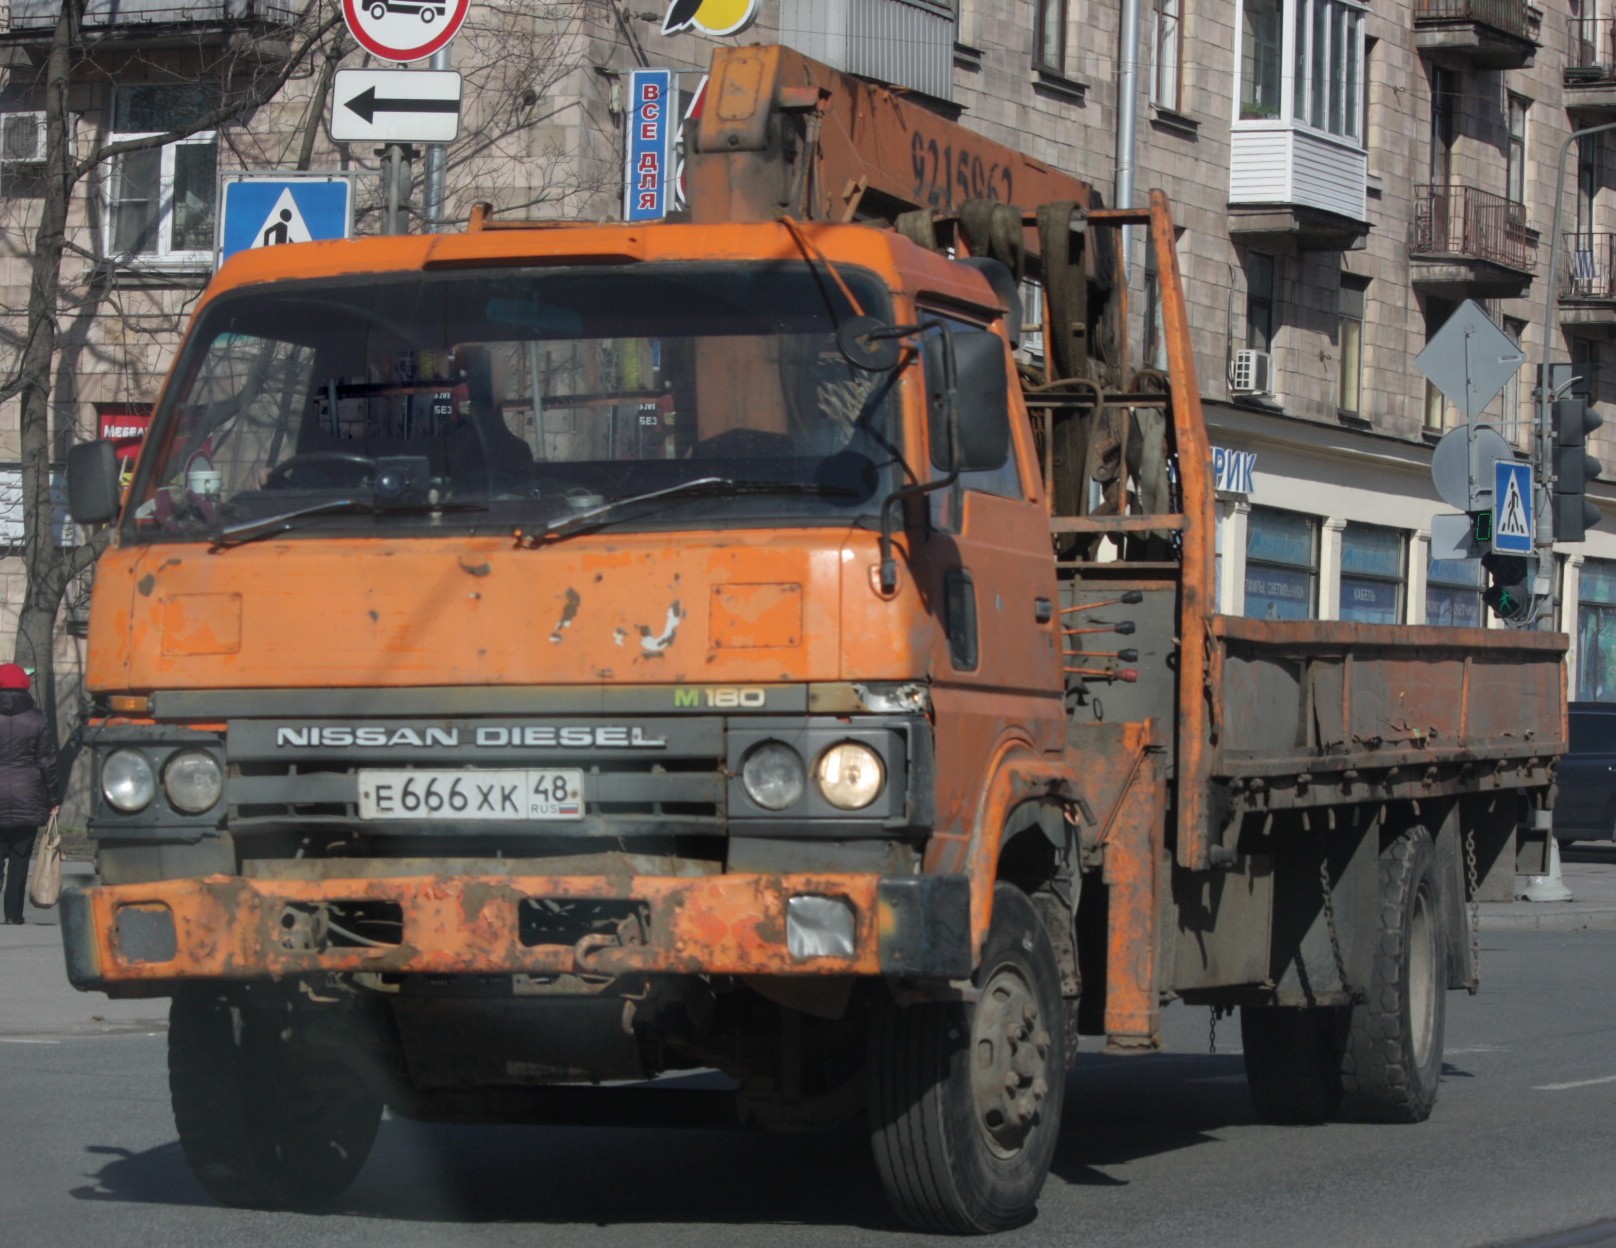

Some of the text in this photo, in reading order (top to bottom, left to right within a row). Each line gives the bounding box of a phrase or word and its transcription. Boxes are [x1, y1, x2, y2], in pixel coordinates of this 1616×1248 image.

[638, 84, 660, 210] ВСЕ ДЛЯ
[103, 424, 148, 438] МЕБЕЛ
[1353, 587, 1376, 602] КАБЕЛЬ
[674, 688, 765, 707] M 180
[276, 727, 668, 748] NISSAN DIESEL
[533, 775, 568, 802] 48
[531, 803, 558, 814] RUS
